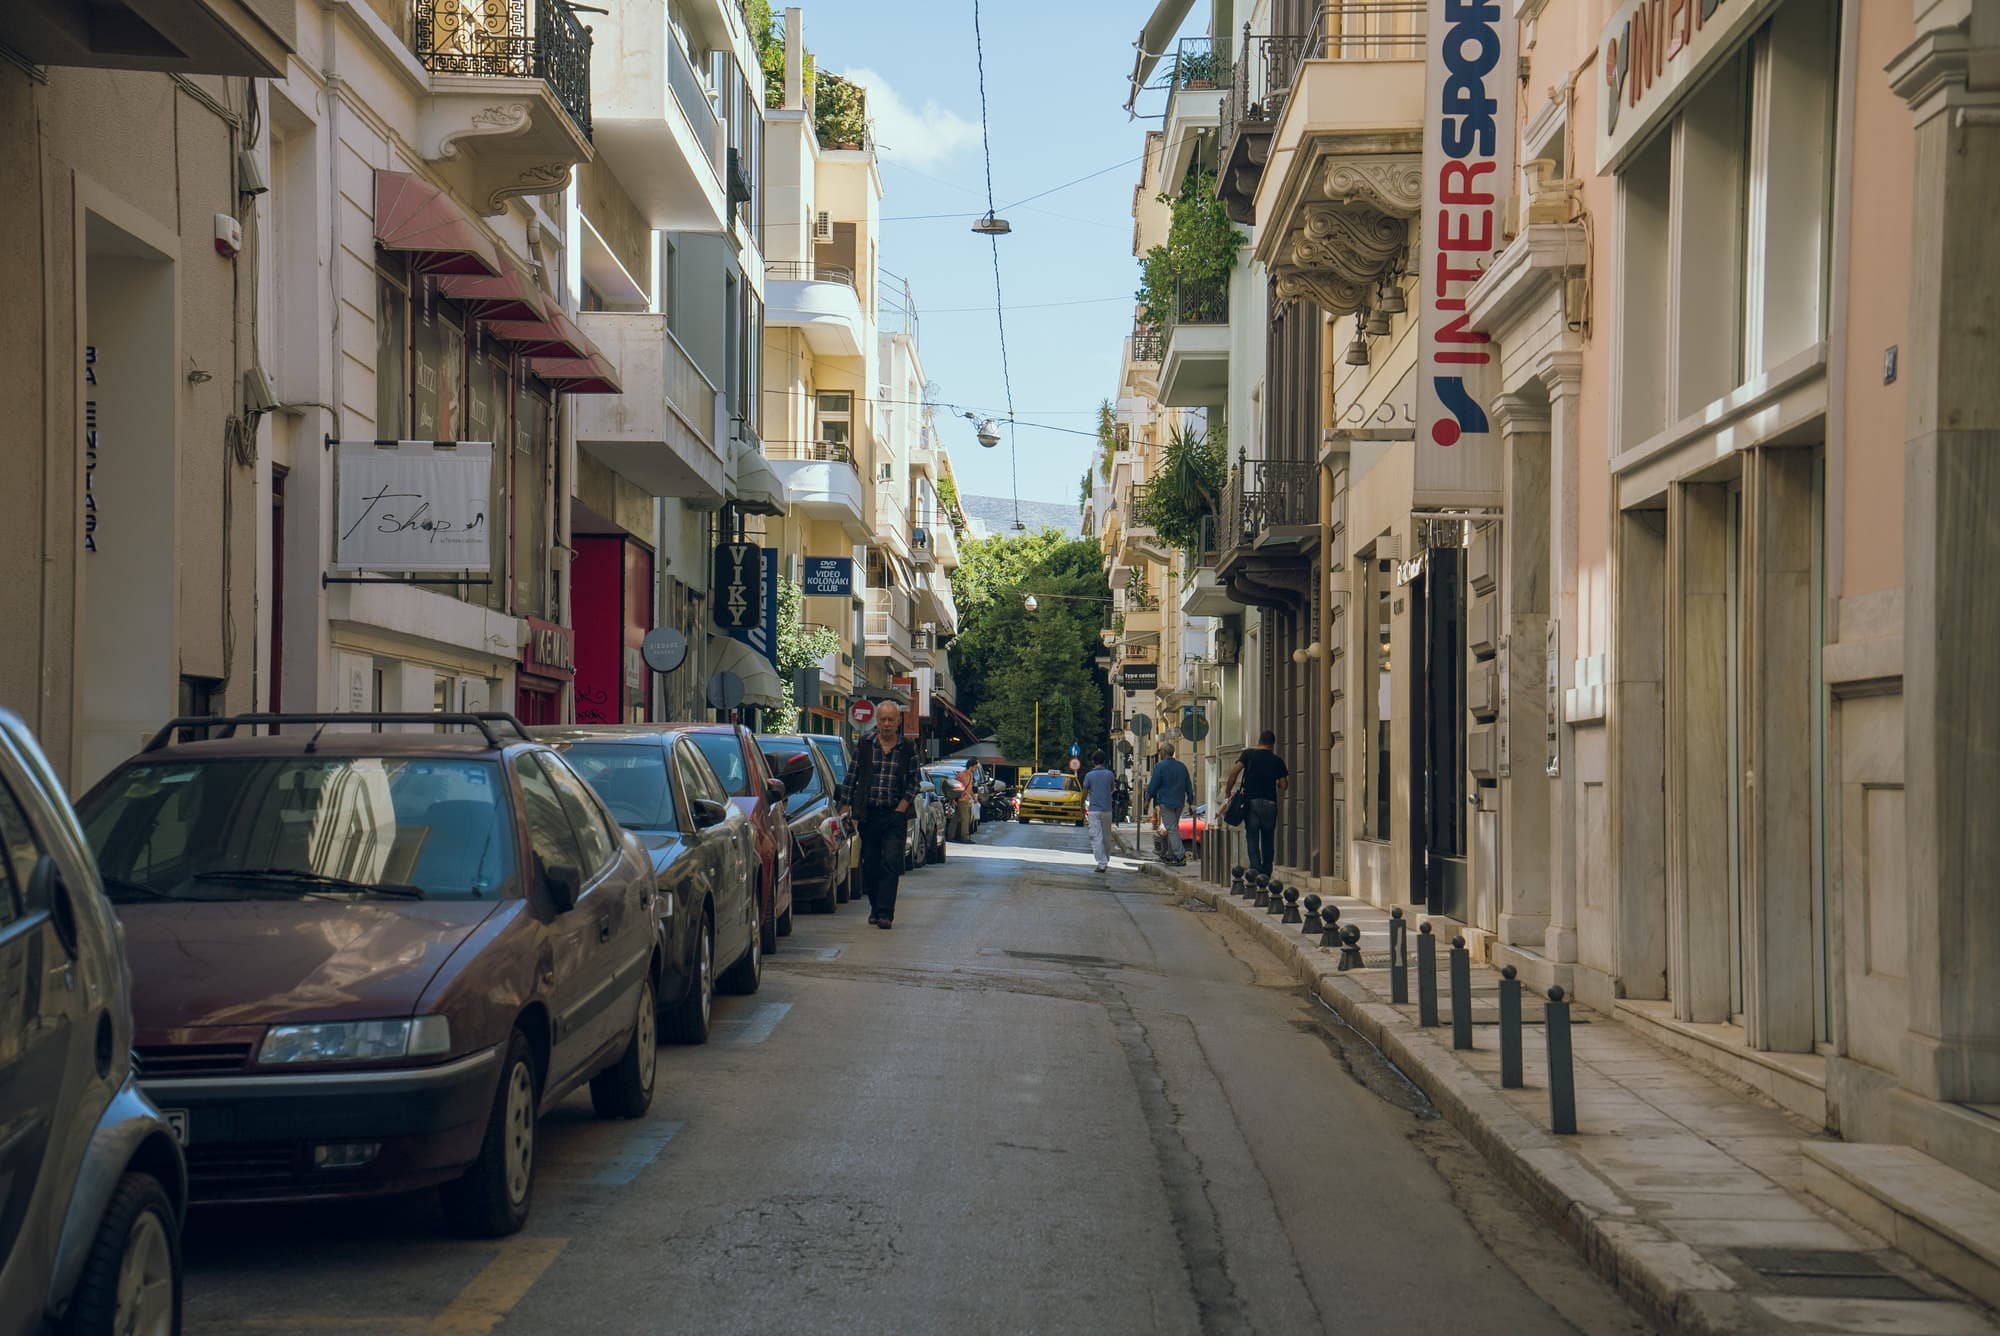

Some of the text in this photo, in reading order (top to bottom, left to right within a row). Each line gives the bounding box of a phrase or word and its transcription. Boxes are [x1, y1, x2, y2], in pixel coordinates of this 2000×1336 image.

[815, 570, 841, 578] VIDEO
[807, 577, 849, 585] KOLONAKI
[728, 545, 748, 626] VIKY
[817, 584, 838, 592] CLUB
